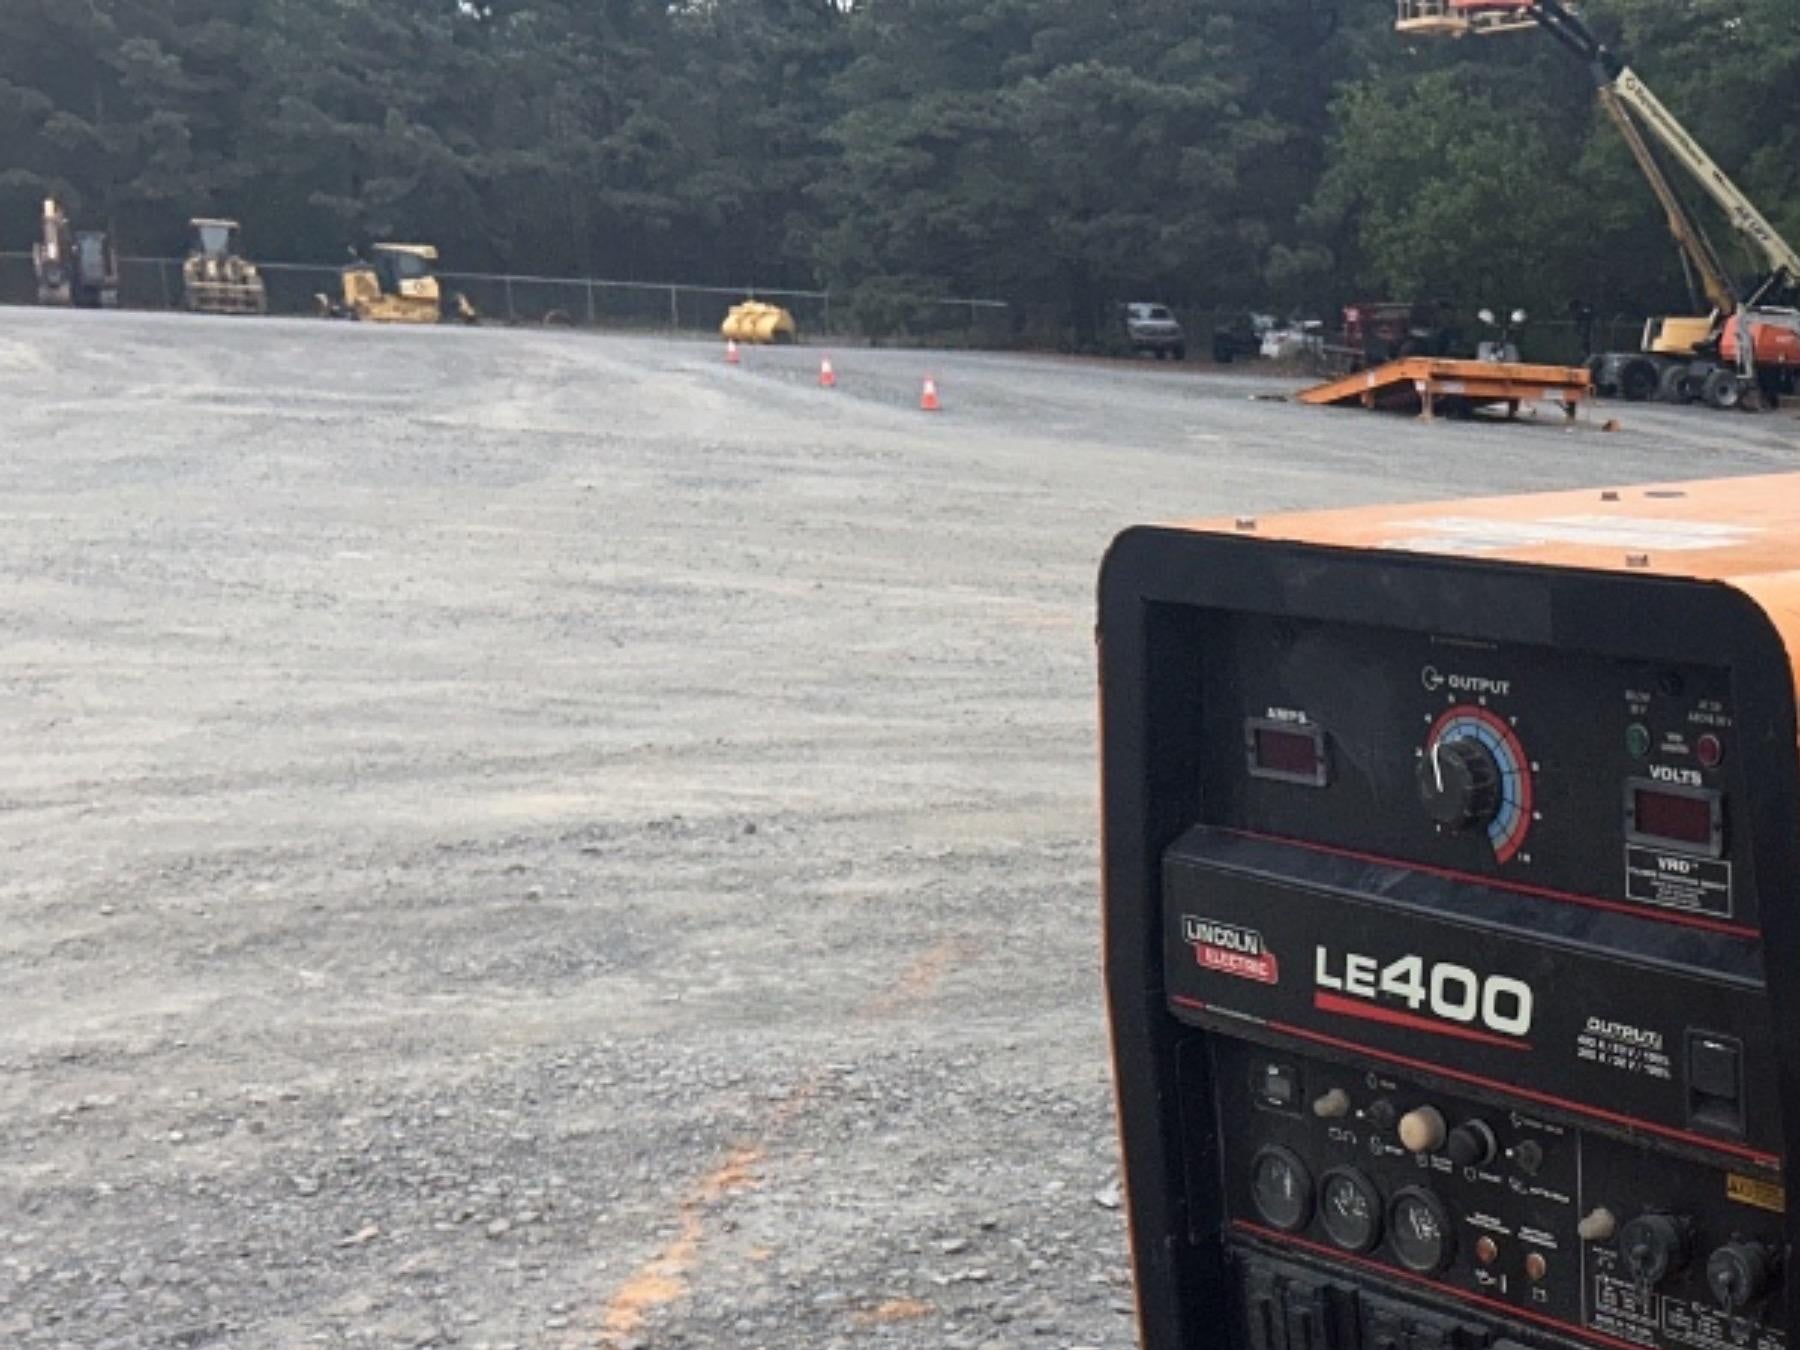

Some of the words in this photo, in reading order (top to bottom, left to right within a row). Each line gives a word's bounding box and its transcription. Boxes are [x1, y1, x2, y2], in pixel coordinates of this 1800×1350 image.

[1448, 673, 1511, 695] OUTPUT
[1187, 918, 1259, 955] LINCOLN
[1315, 944, 1533, 1036] LE400
